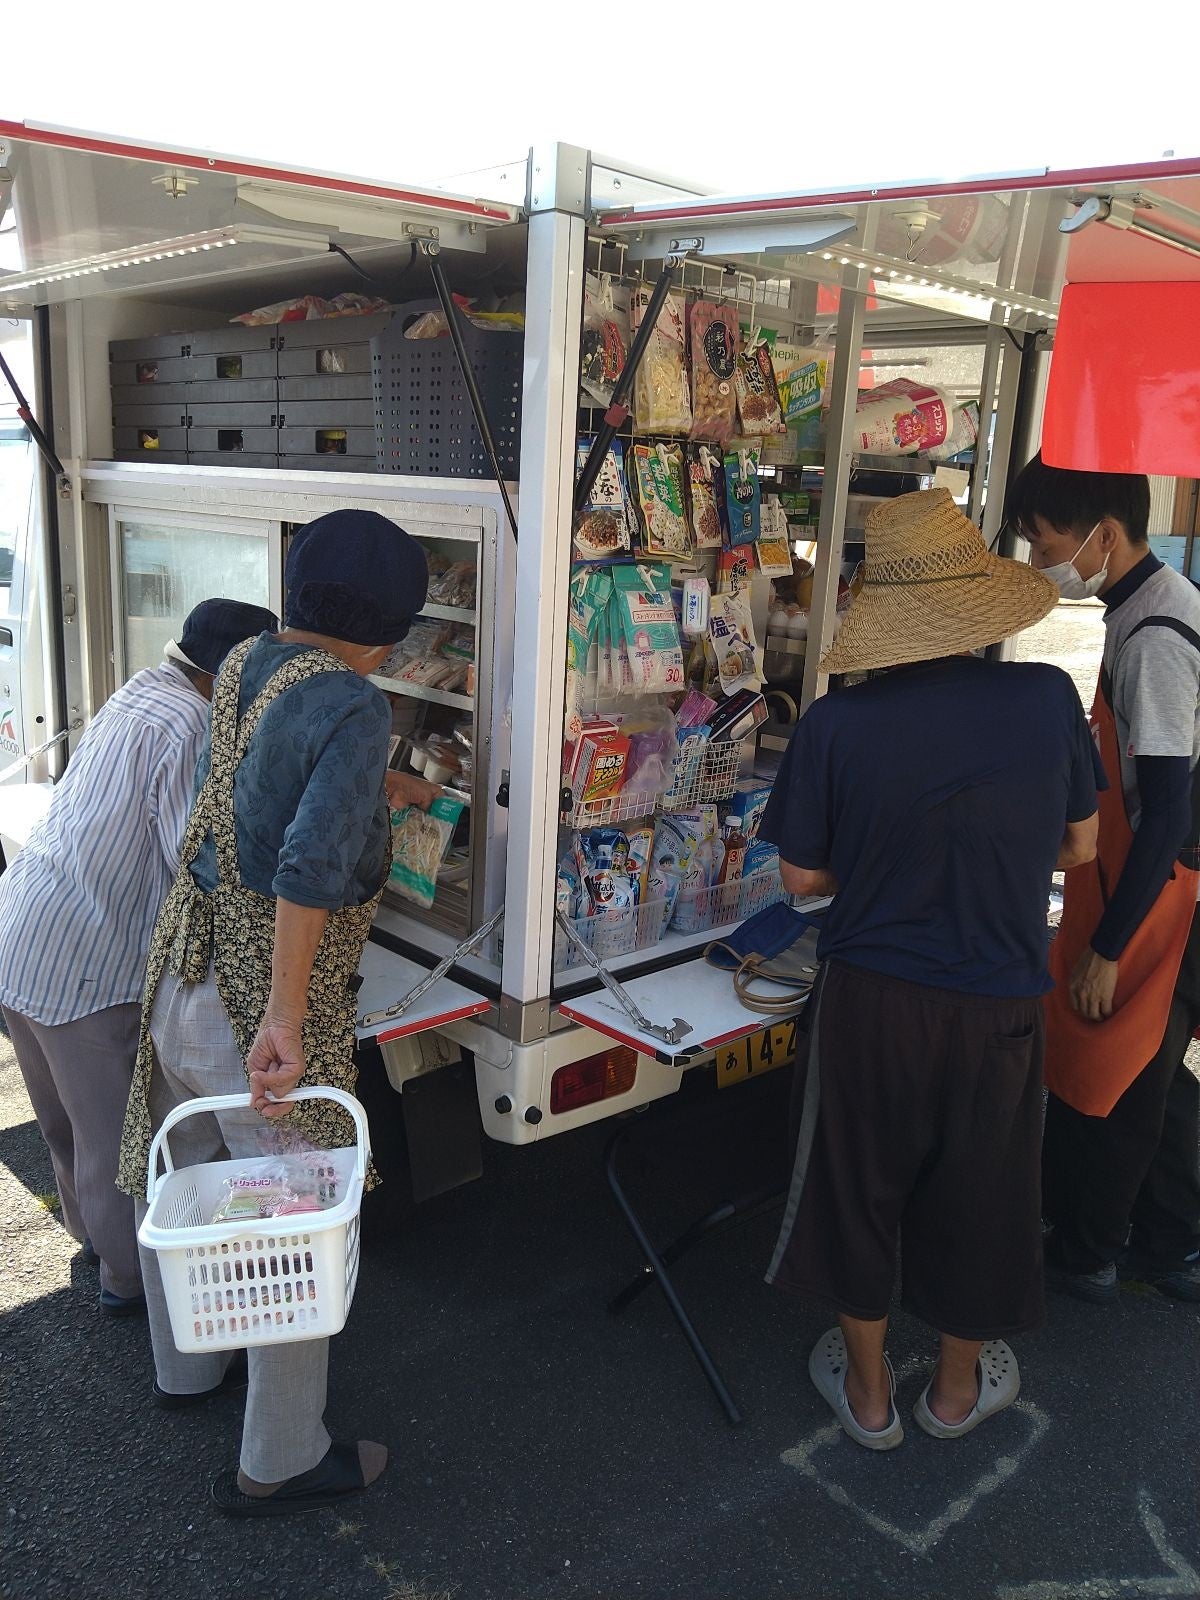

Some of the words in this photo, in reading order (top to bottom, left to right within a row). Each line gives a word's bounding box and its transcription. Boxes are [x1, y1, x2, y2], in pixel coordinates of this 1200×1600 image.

[931, 403, 944, 437] スコッティ
[595, 754, 625, 770] 固める
[725, 1052, 738, 1071] あ
[746, 1020, 797, 1073] 14-2
[239, 1179, 271, 1187] リョーユーパン
